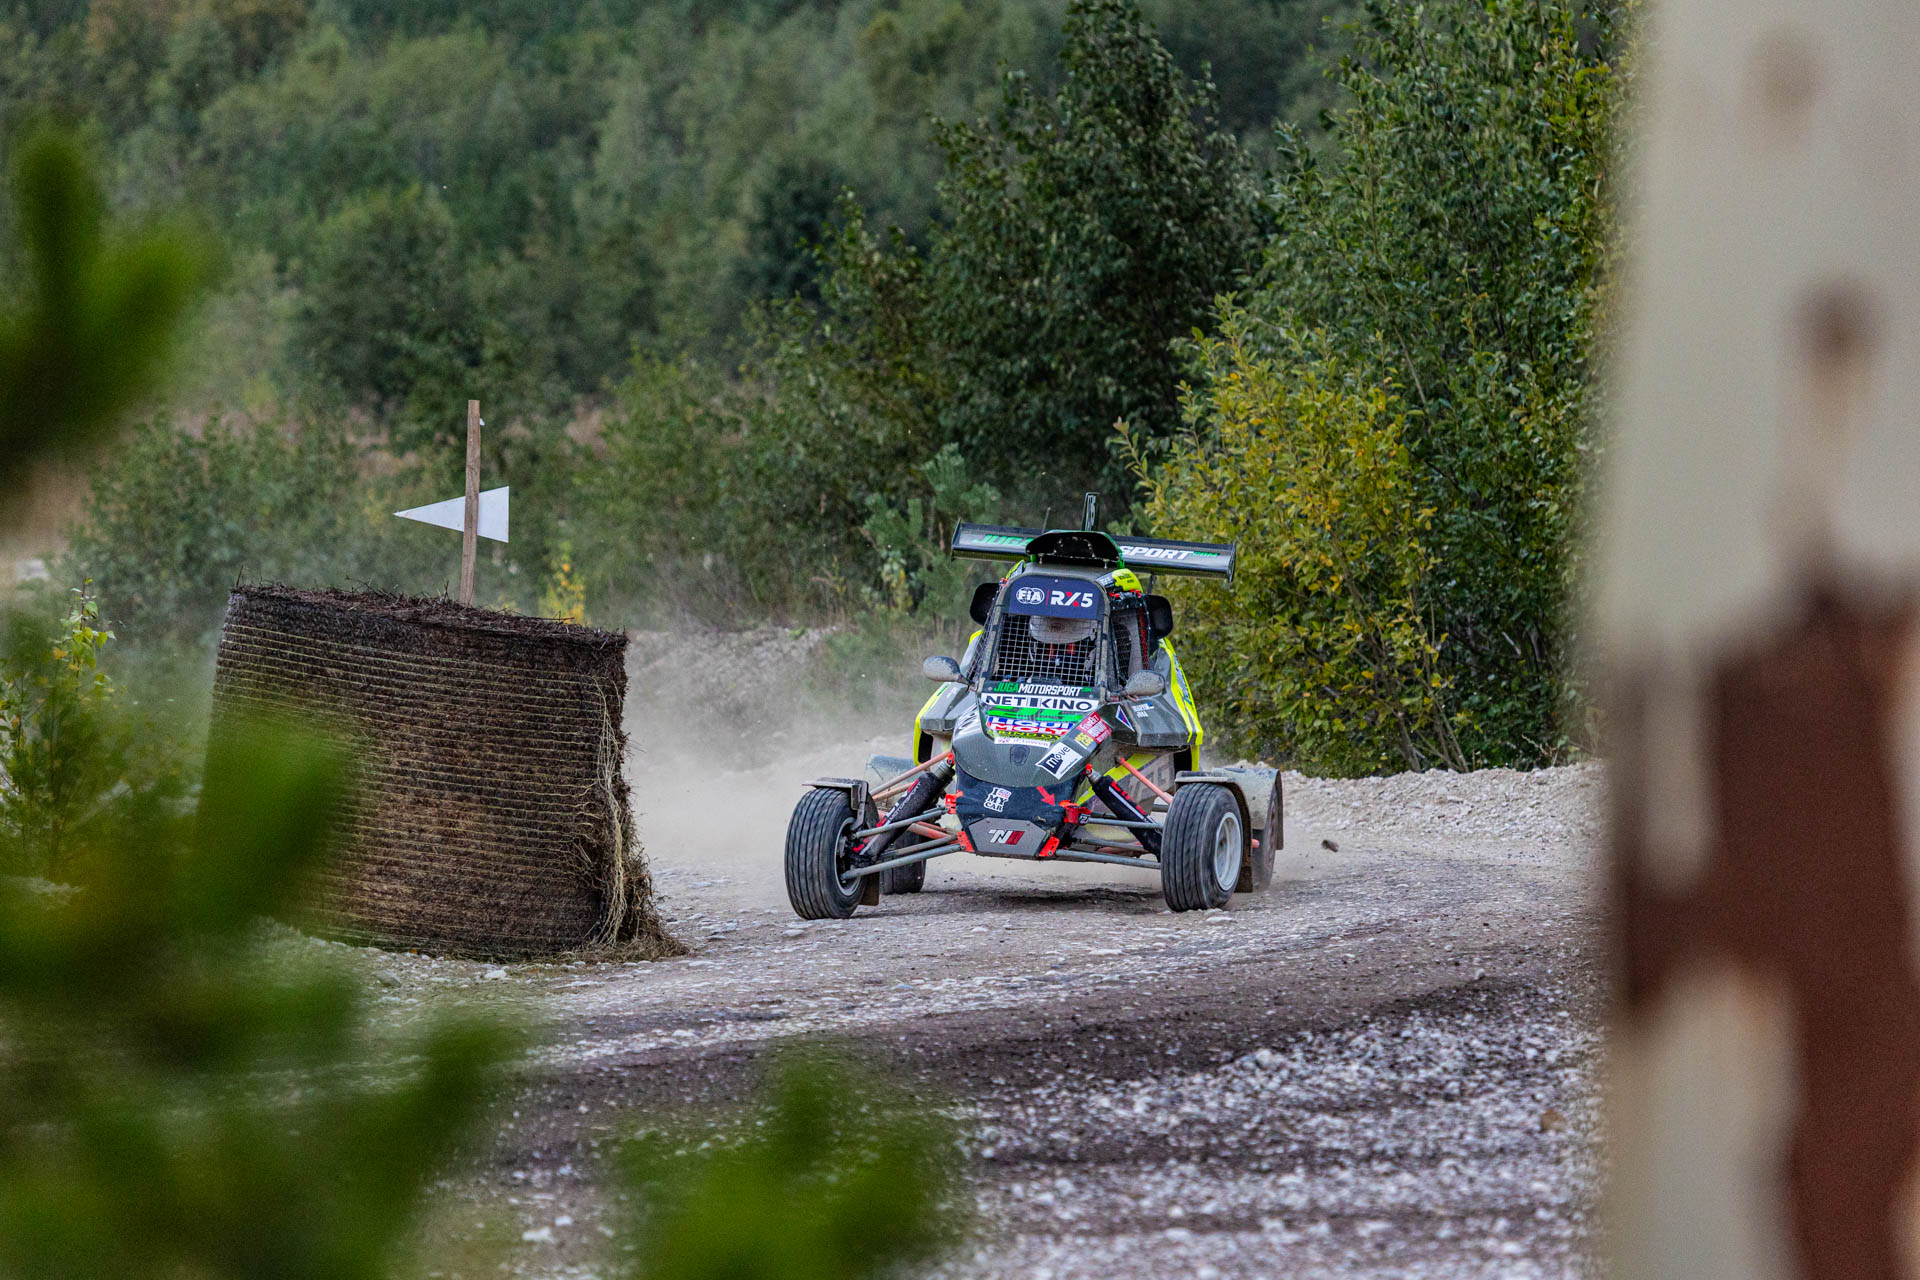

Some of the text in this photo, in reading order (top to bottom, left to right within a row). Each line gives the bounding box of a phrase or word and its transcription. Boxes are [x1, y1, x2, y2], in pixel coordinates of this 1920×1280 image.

[1016, 588, 1094, 608] FIA RX5
[990, 723, 1071, 736] MOLY
[1046, 746, 1071, 768] move
[986, 794, 1008, 805] MY
[984, 801, 1003, 812] CAR
